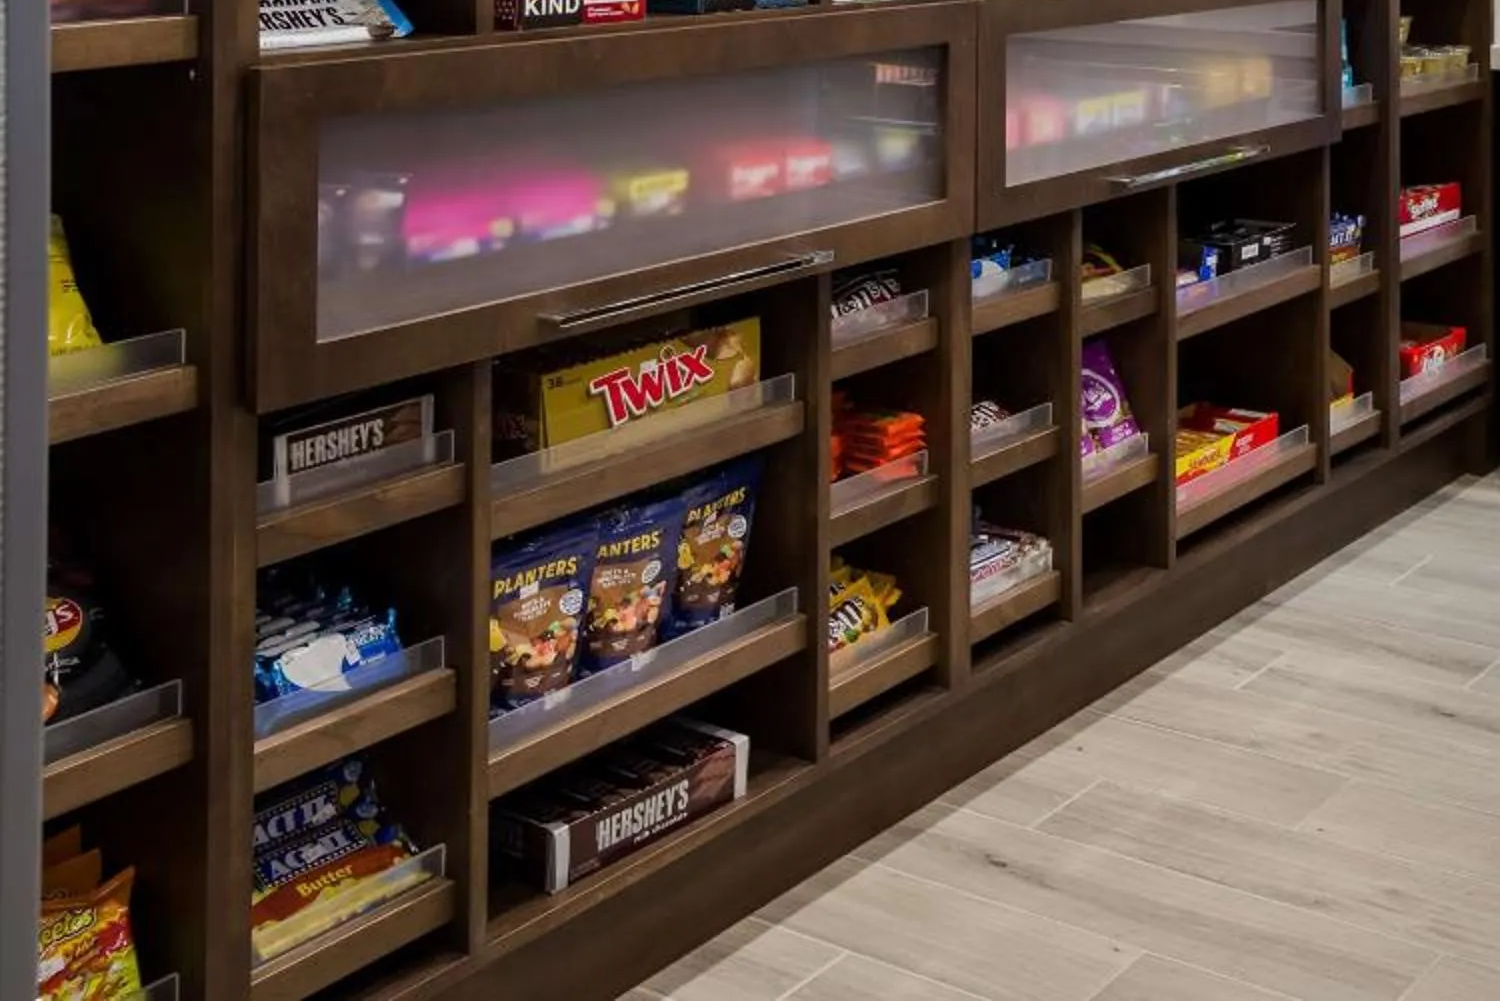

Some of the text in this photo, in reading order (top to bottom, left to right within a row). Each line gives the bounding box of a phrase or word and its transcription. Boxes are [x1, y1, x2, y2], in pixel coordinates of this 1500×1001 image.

[260, 7, 345, 32] RSHEY'S
[290, 418, 385, 471] HERSHEY'S
[596, 530, 661, 559] ANTERS
[493, 555, 578, 600] PLANTERS
[595, 779, 690, 854] HERSHEY'S
[295, 863, 354, 898] Butter
